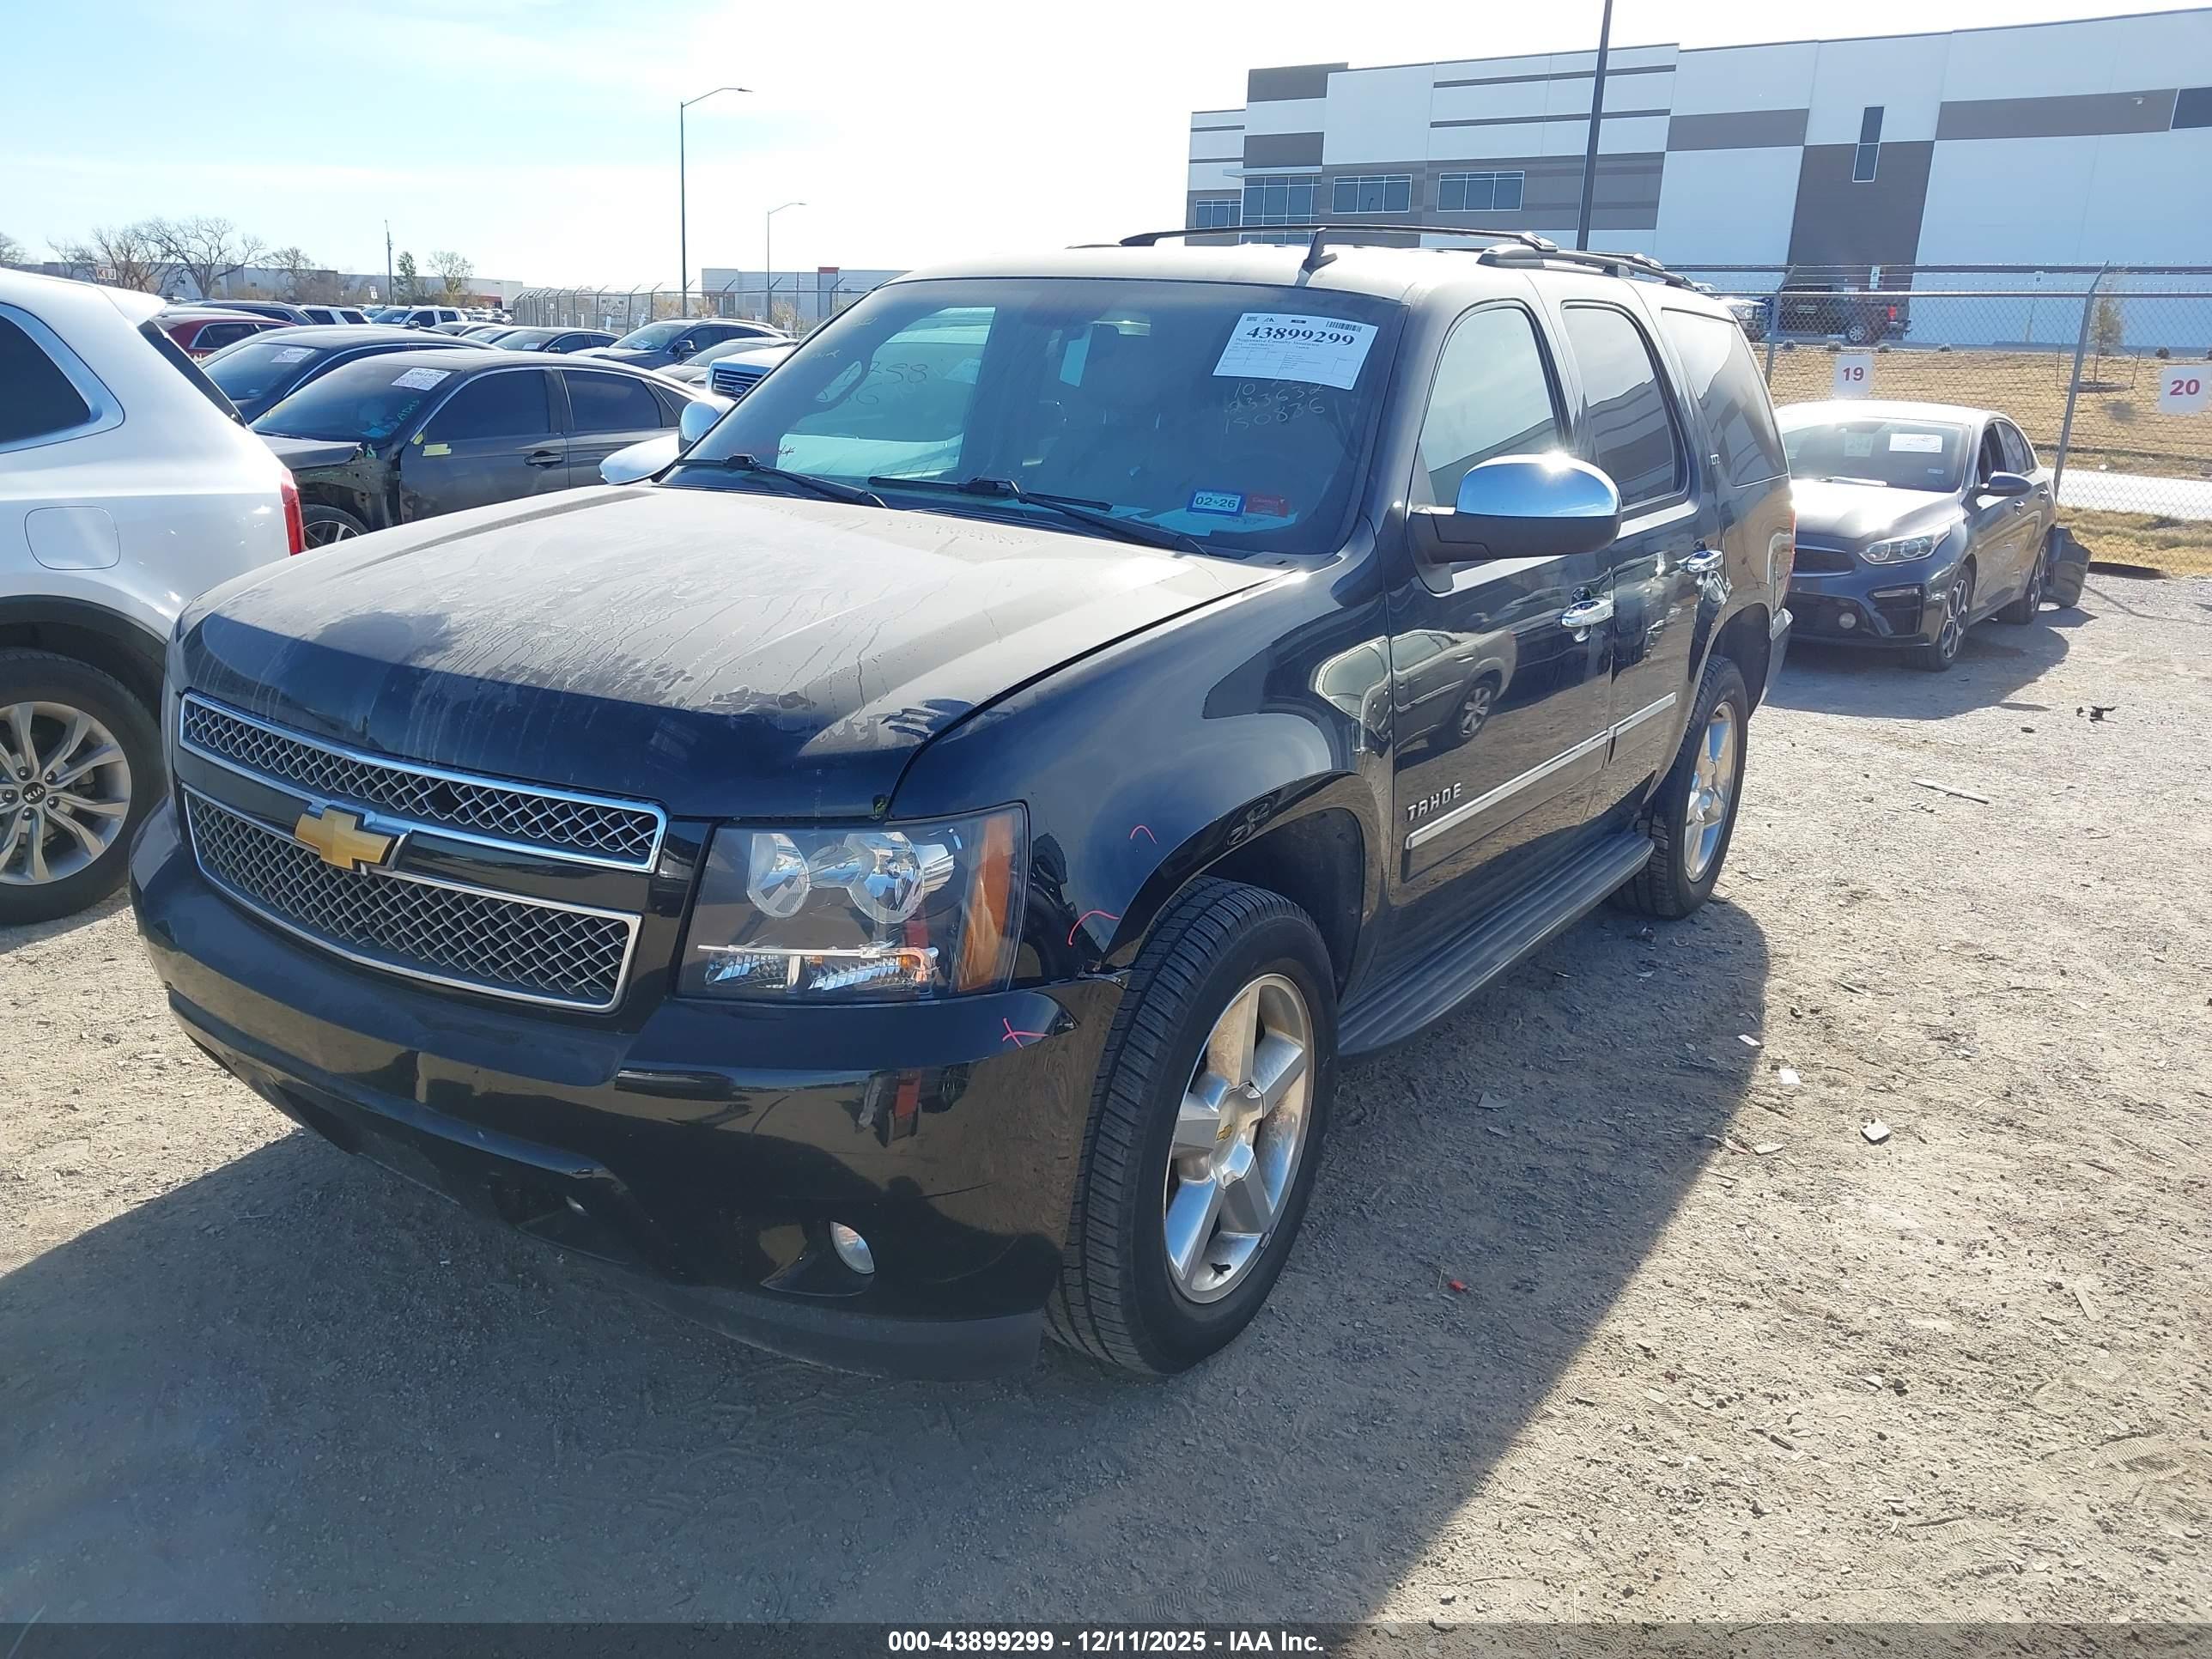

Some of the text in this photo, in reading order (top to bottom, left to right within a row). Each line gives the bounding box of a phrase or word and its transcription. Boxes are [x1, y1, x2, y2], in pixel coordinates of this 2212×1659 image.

[1246, 326, 1355, 346] 43899299
[1843, 367, 1864, 381] 19
[2170, 379, 2200, 395] 20
[25, 787, 44, 800] KIA
[1408, 782, 1461, 821] TAHOE
